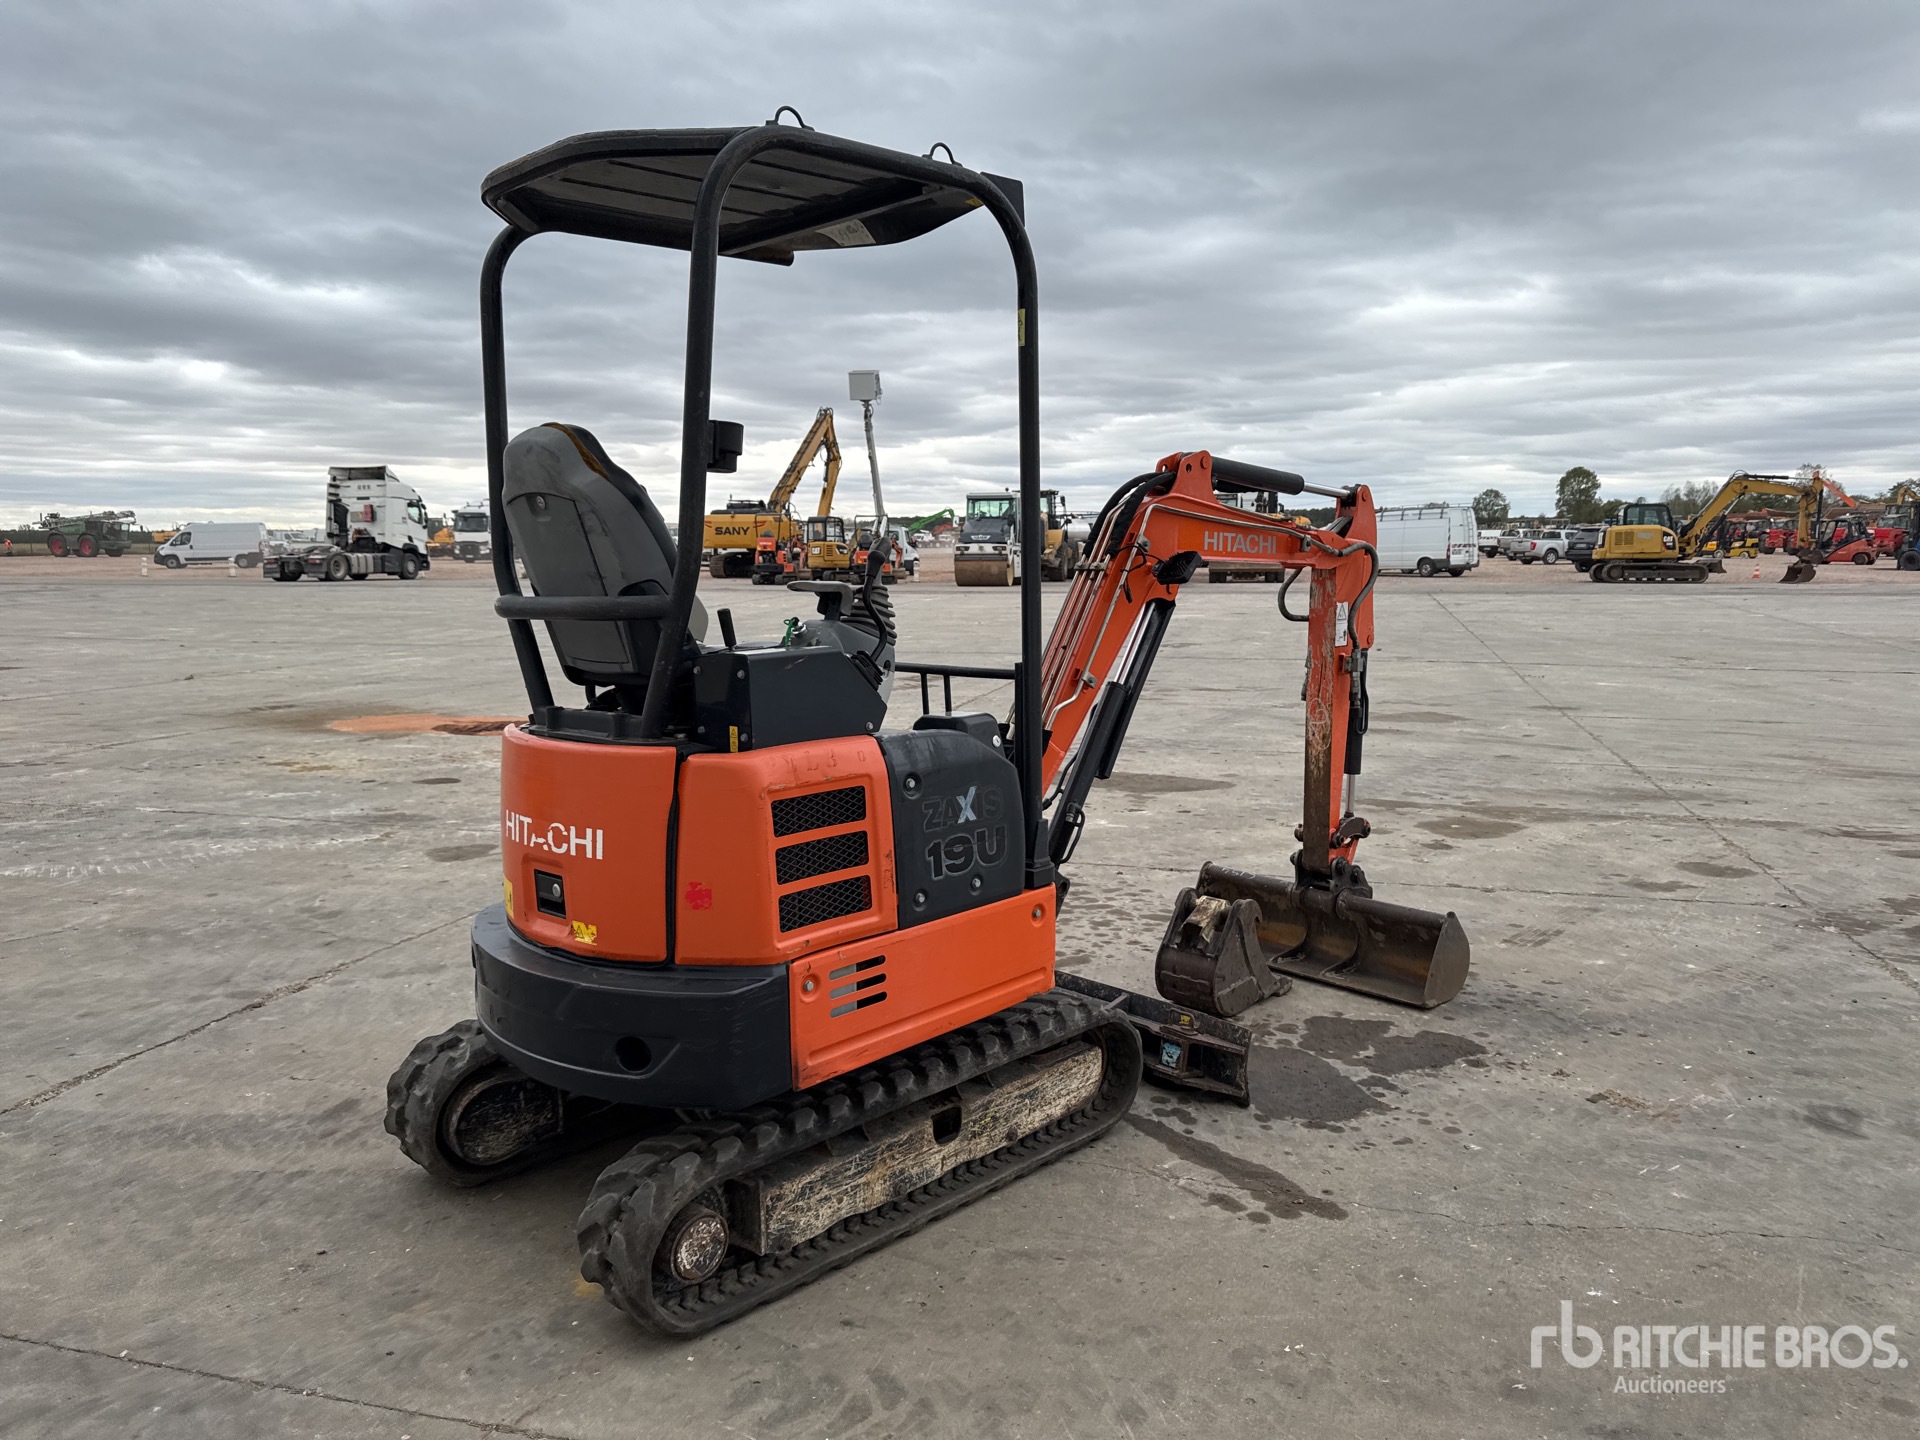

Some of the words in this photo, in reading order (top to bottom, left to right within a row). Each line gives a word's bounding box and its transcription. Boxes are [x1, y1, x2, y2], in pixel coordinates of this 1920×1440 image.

[715, 527, 750, 535] SANY
[1204, 530, 1277, 554] HITACHI
[923, 786, 1002, 832] ZAXIS
[505, 809, 603, 860] HITACHI
[926, 825, 1007, 880] 19U
